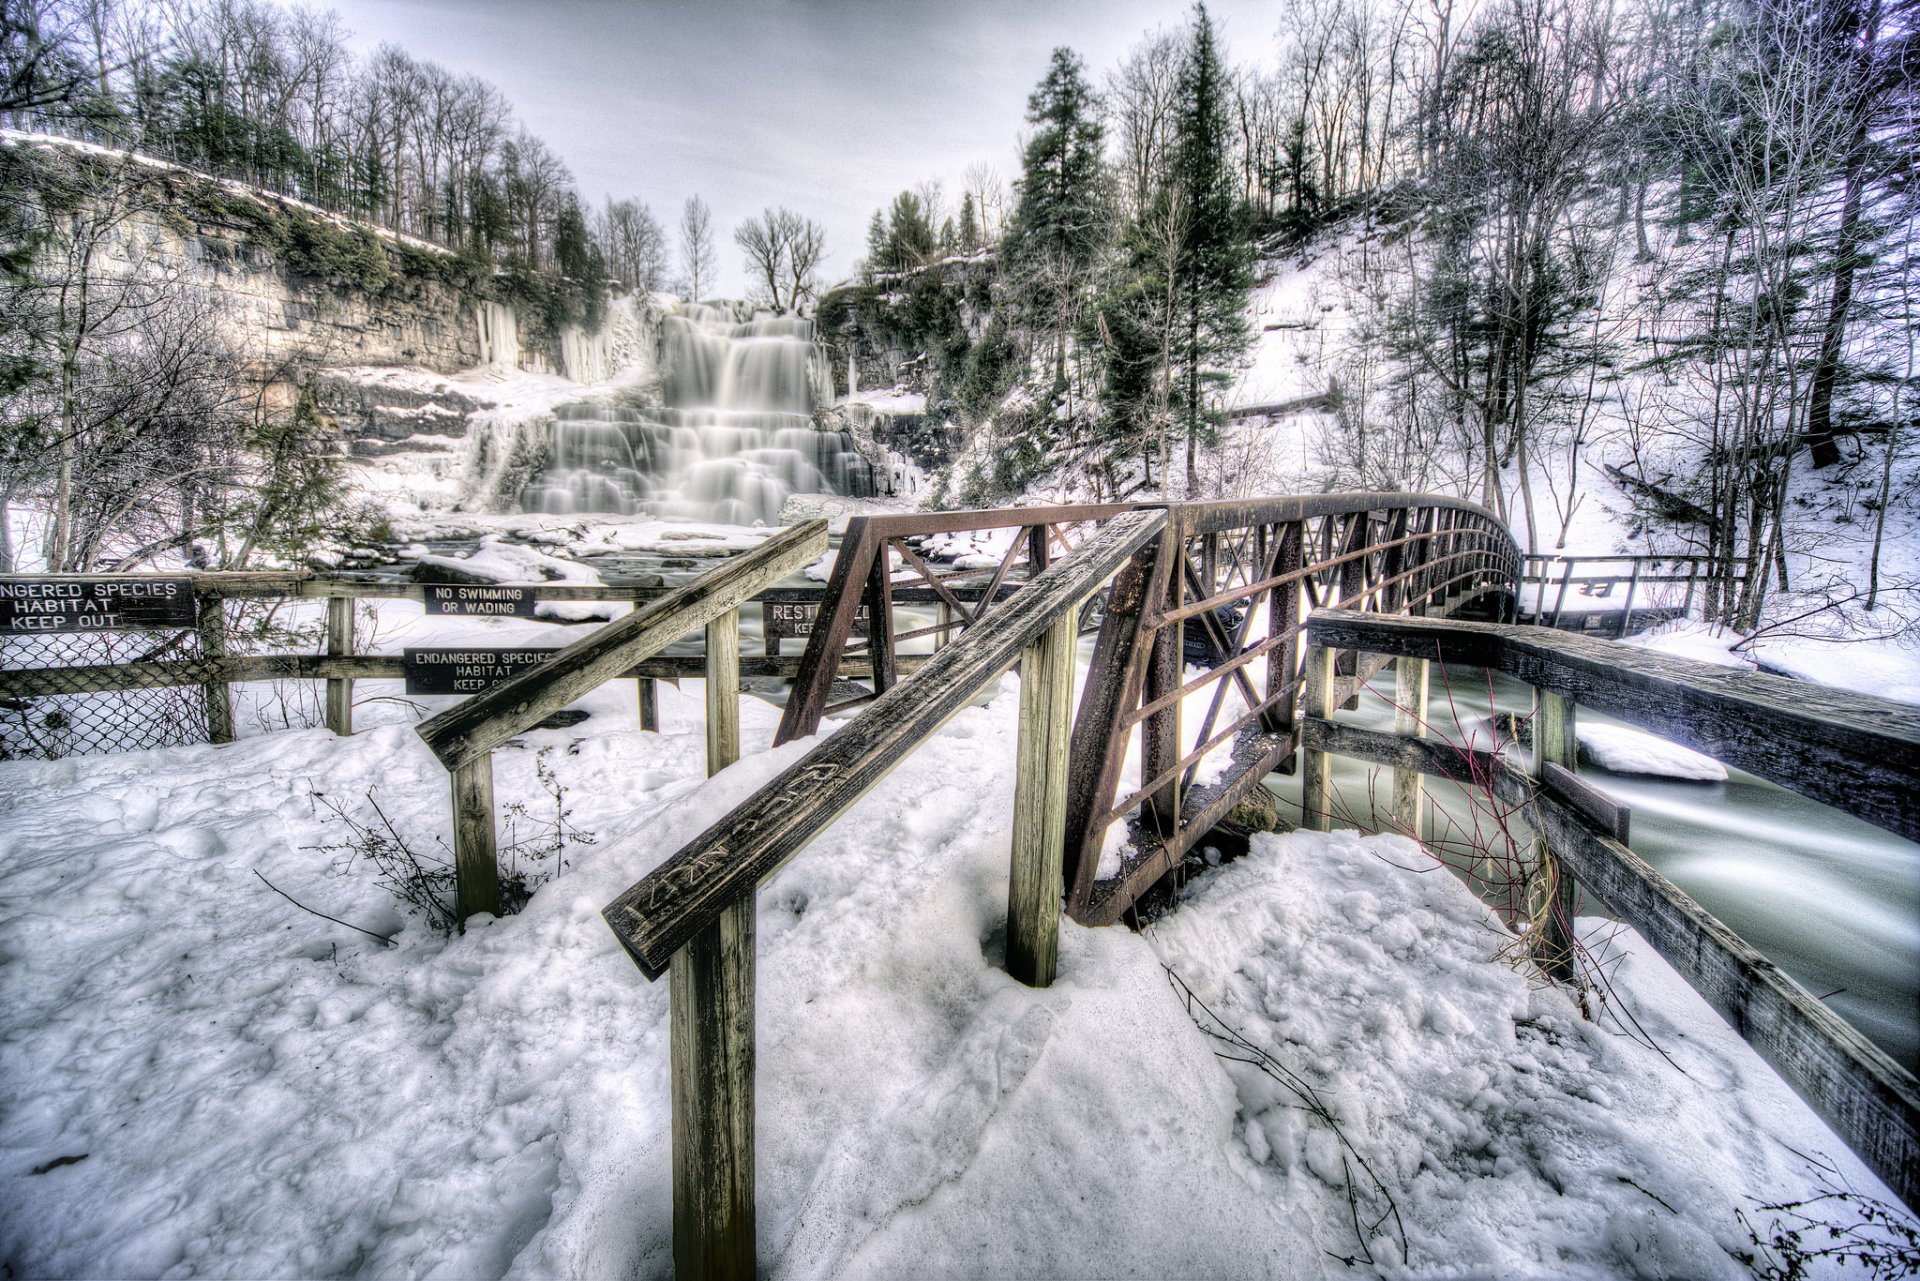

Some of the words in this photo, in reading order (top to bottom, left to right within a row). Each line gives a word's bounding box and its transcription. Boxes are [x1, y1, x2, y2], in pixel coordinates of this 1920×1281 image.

[94, 583, 177, 597] SPECIES
[435, 587, 452, 599] NO
[458, 588, 522, 600] SWIMMING
[14, 599, 112, 613] HABITAT
[442, 601, 458, 613] OR
[465, 602, 515, 614] WADING
[11, 616, 66, 630] KEEP
[79, 614, 119, 628] OUT
[794, 622, 814, 634] KEE
[415, 653, 496, 665] ENDANGERED
[456, 665, 513, 677] HABITAT
[453, 679, 486, 691] KEEP
